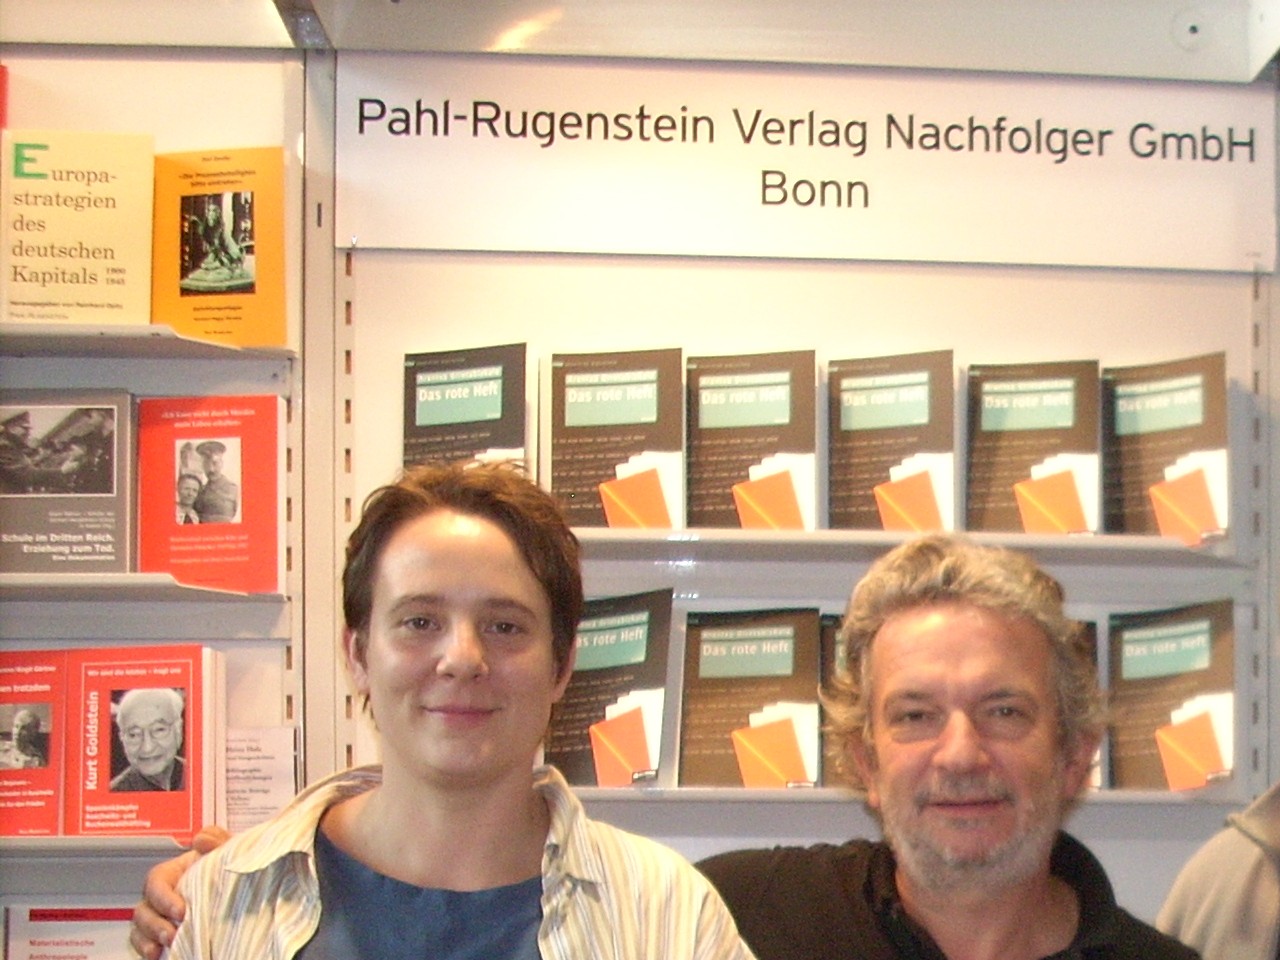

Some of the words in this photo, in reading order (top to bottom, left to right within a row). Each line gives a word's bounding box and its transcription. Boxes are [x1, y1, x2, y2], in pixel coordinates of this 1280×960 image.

[358, 97, 715, 148] Pahl-Rugenstein
[733, 108, 867, 157] Verlag
[886, 113, 1113, 163] Nachfolger
[1129, 122, 1256, 162] GmbH
[760, 169, 870, 208] Bonn
[13, 191, 117, 212] strategien
[12, 213, 46, 232] des
[12, 239, 115, 260] deutschen
[11, 265, 98, 288] Kapitals
[419, 388, 442, 402] Das
[445, 387, 470, 400] rote
[473, 380, 498, 398] Heft
[568, 389, 592, 403] Das
[596, 389, 623, 402] rote
[2, 534, 33, 543] Schule
[35, 533, 48, 542] im
[49, 533, 84, 542] Dritten
[85, 533, 115, 542] Reich.
[592, 634, 617, 647] rote
[620, 626, 644, 643] Heft
[702, 644, 726, 656] Das
[731, 643, 758, 656] rote
[762, 639, 790, 654] Heft
[85, 691, 99, 756] Goldstein
[84, 759, 98, 791] Kurt
